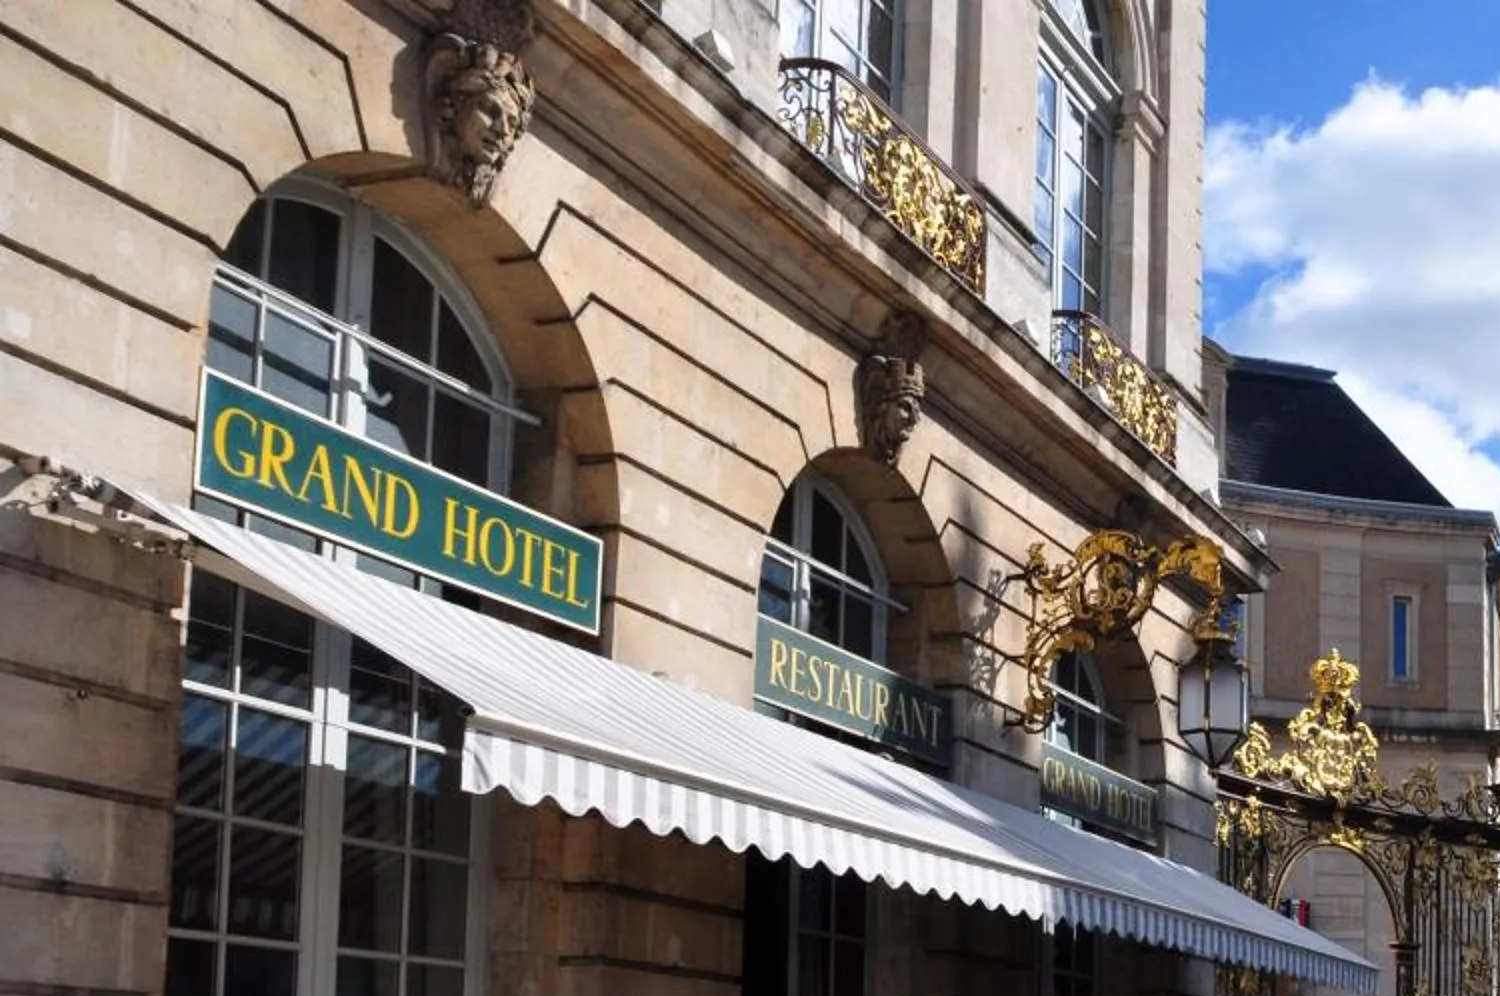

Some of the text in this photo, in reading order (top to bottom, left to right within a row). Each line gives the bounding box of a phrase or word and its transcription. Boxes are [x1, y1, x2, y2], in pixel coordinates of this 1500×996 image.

[213, 407, 589, 609] GRAND HOTEL
[768, 637, 944, 747] RESTAURANT
[1043, 756, 1154, 832] GRAND HOTEL
